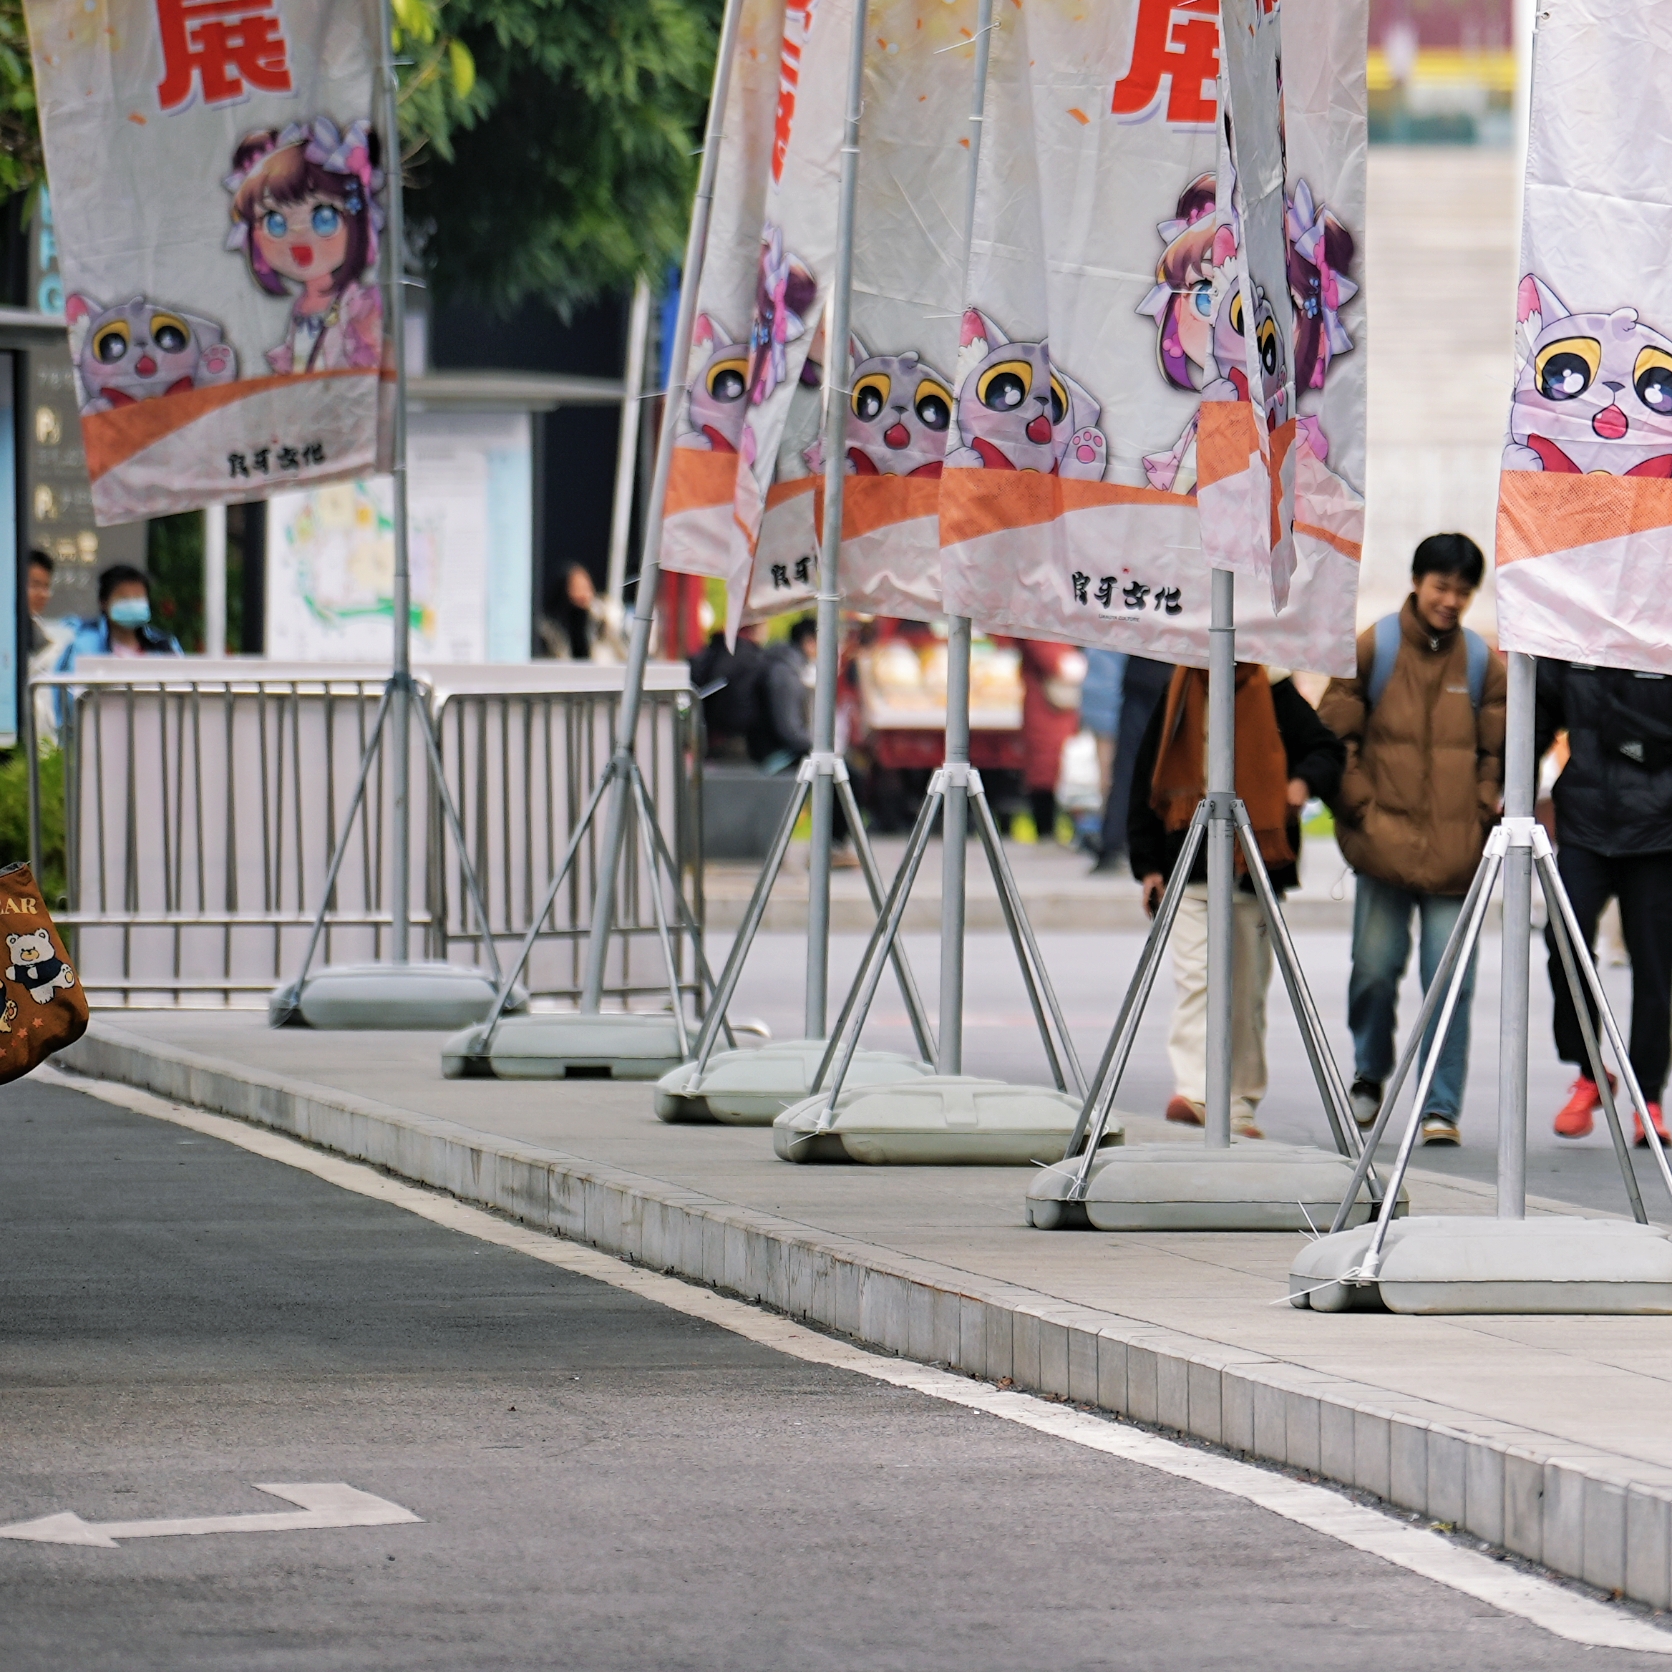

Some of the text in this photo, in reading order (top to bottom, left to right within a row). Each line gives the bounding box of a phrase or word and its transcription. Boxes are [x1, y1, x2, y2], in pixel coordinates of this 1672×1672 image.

[228, 442, 325, 478] 良牙文化
[771, 556, 818, 590] 良牙
[1072, 571, 1183, 616] 良牙文化
[0, 897, 38, 915] AR
